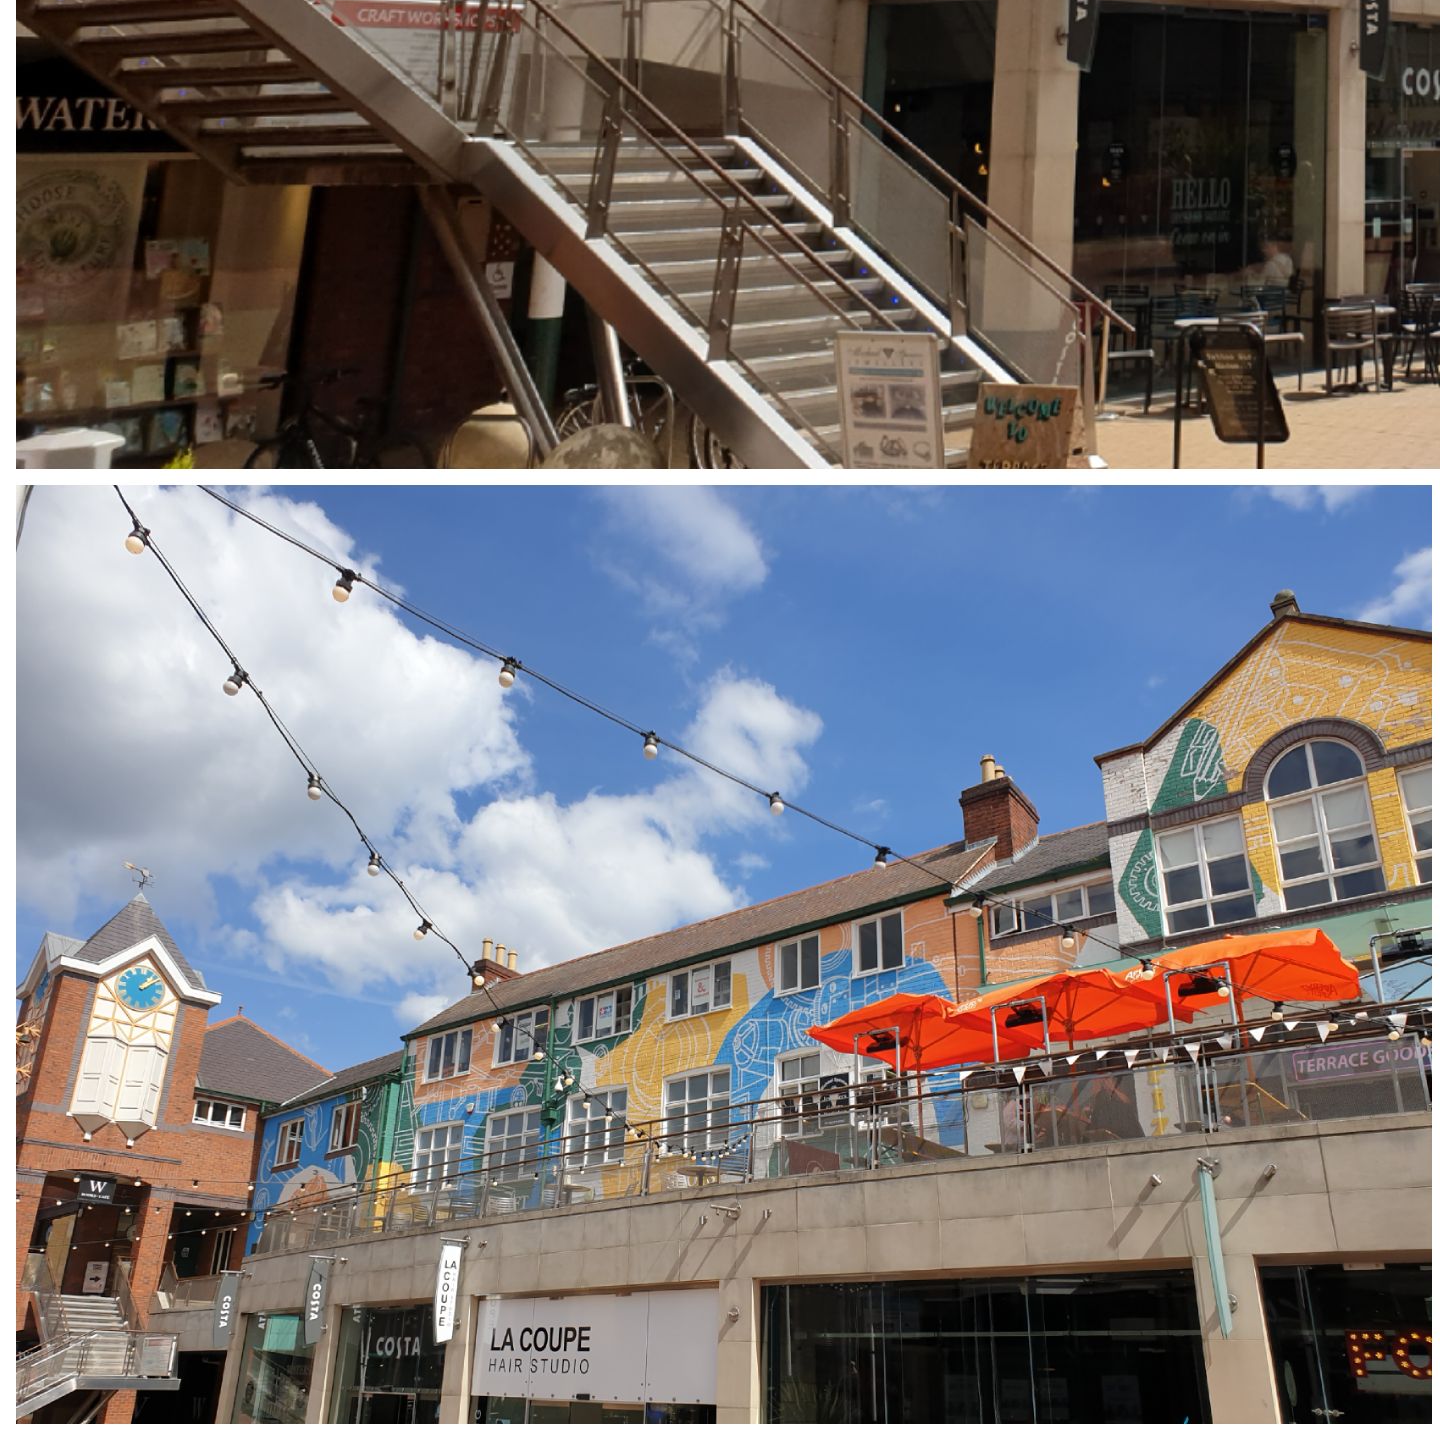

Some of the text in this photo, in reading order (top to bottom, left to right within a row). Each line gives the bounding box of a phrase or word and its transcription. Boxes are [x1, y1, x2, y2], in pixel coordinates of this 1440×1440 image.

[357, 8, 405, 24] CRAFT
[1171, 176, 1232, 210] HELLO
[1297, 1045, 1432, 1074] TERRACE GOOD
[90, 1180, 108, 1193] W
[444, 1260, 457, 1270] LA
[218, 1295, 232, 1328] COSTA
[311, 1283, 322, 1321] COSTA
[438, 1271, 450, 1327] COUPE
[375, 1336, 421, 1360] COSTA
[490, 1326, 592, 1352] LA COUPE
[488, 1358, 590, 1375] HAIR STUDIO
